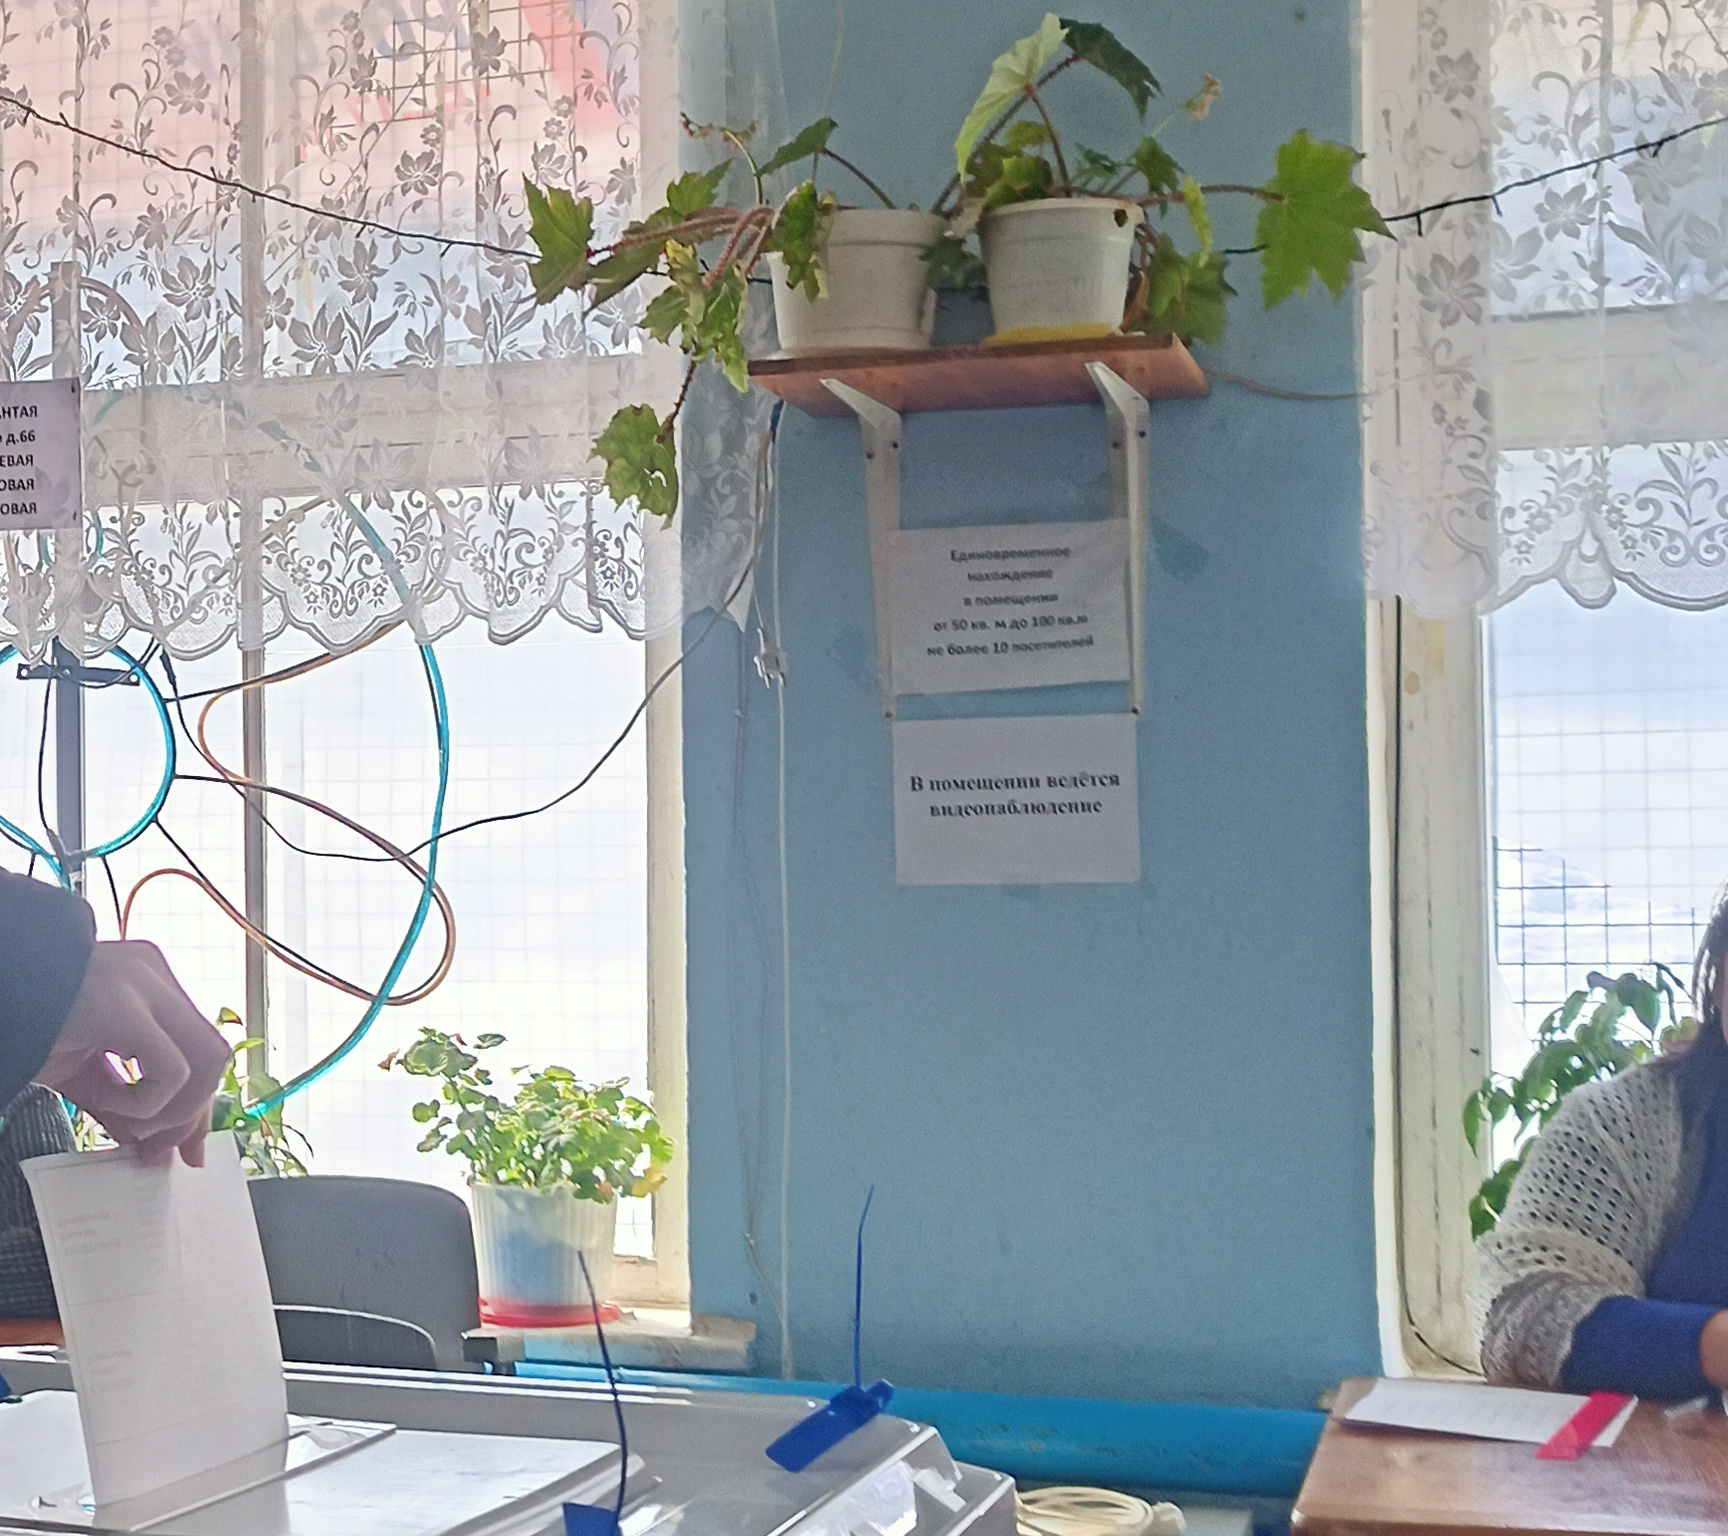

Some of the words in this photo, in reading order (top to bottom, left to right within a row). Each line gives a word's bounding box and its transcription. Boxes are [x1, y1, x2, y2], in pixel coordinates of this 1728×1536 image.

[5, 429, 36, 446] д.66
[950, 546, 1071, 563] Единовременное
[952, 618, 969, 631] 50
[1032, 615, 1056, 628] 100
[947, 642, 989, 656] более
[993, 641, 1010, 654] 10
[910, 775, 924, 792] В
[929, 774, 1041, 792] помещении
[929, 798, 1103, 818] видеонаблюдение
